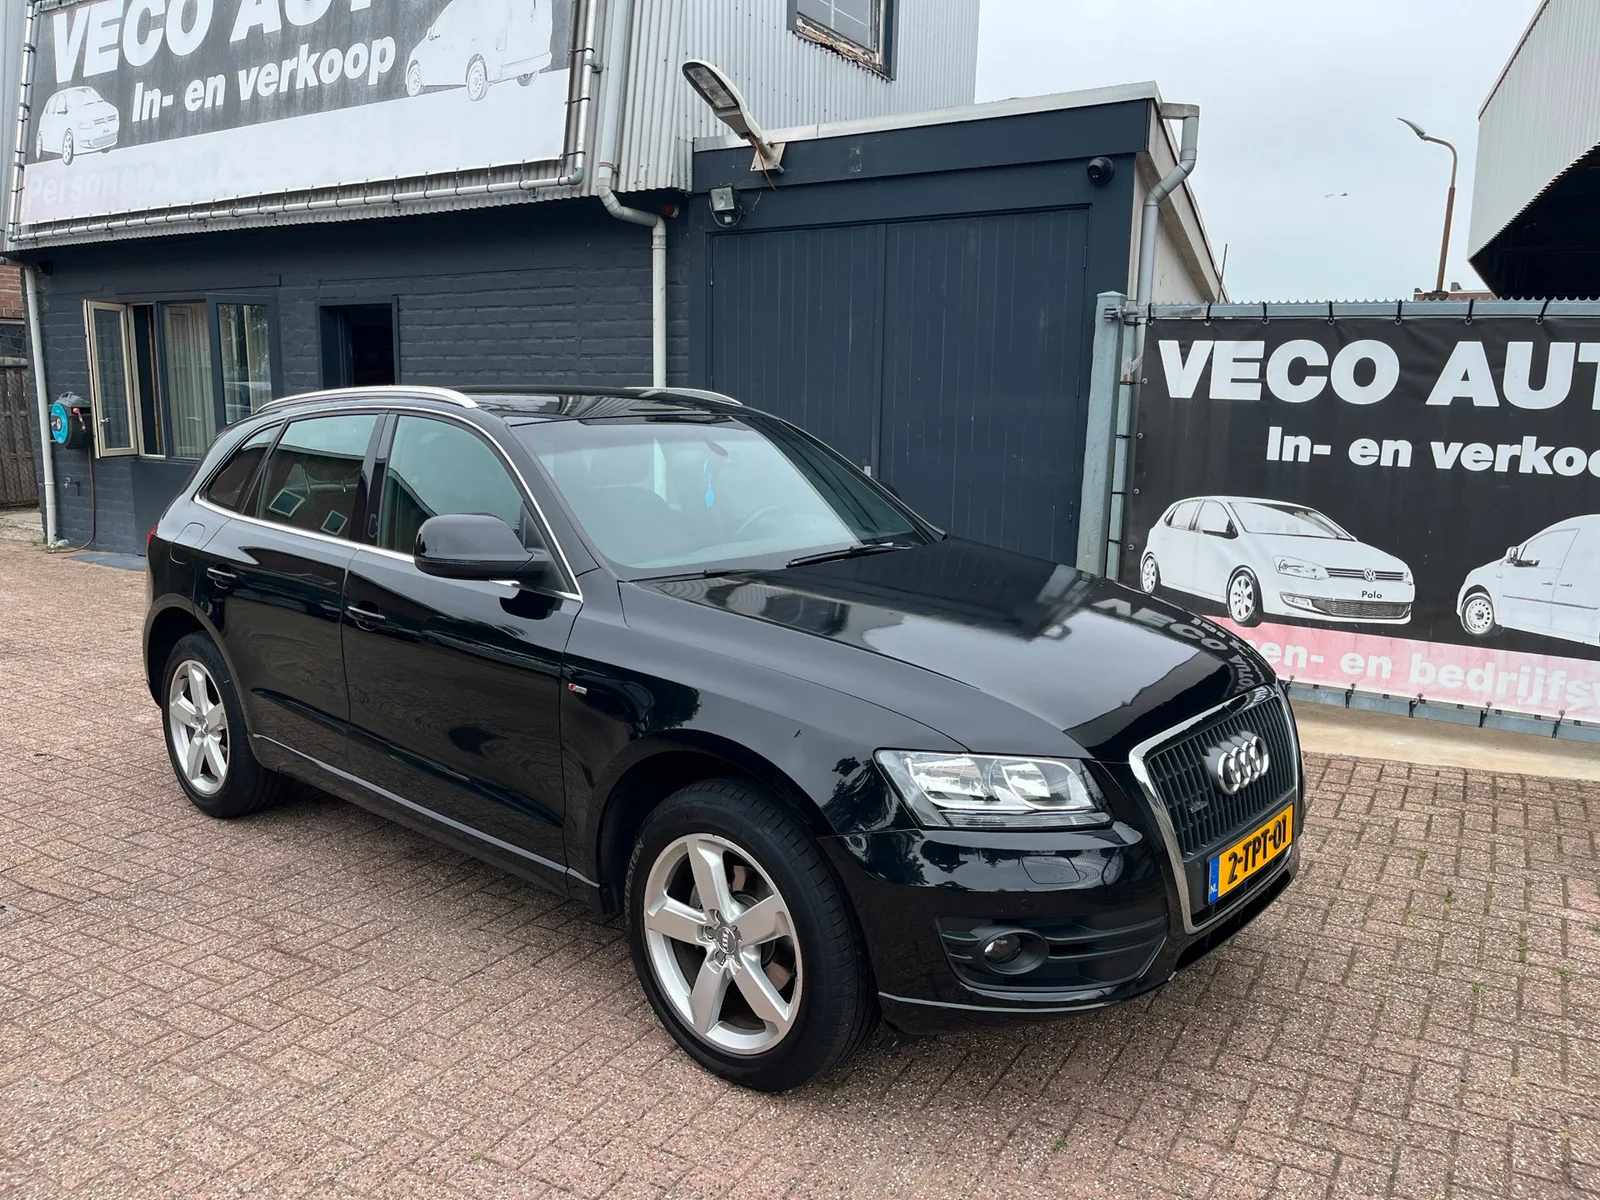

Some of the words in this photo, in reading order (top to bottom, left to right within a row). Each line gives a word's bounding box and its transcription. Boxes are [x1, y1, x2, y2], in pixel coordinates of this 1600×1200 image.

[53, 0, 213, 84] VECO
[131, 82, 174, 122] In-
[184, 72, 227, 112] en
[237, 36, 396, 102] verkoop
[1158, 339, 1400, 405] VECO
[1266, 426, 1332, 463] In-
[1348, 436, 1413, 468] en
[1361, 590, 1383, 599] Polo
[1339, 654, 1393, 680] en
[1408, 652, 1600, 711] bedrijfs
[1227, 814, 1287, 885] 2-TPT-01
